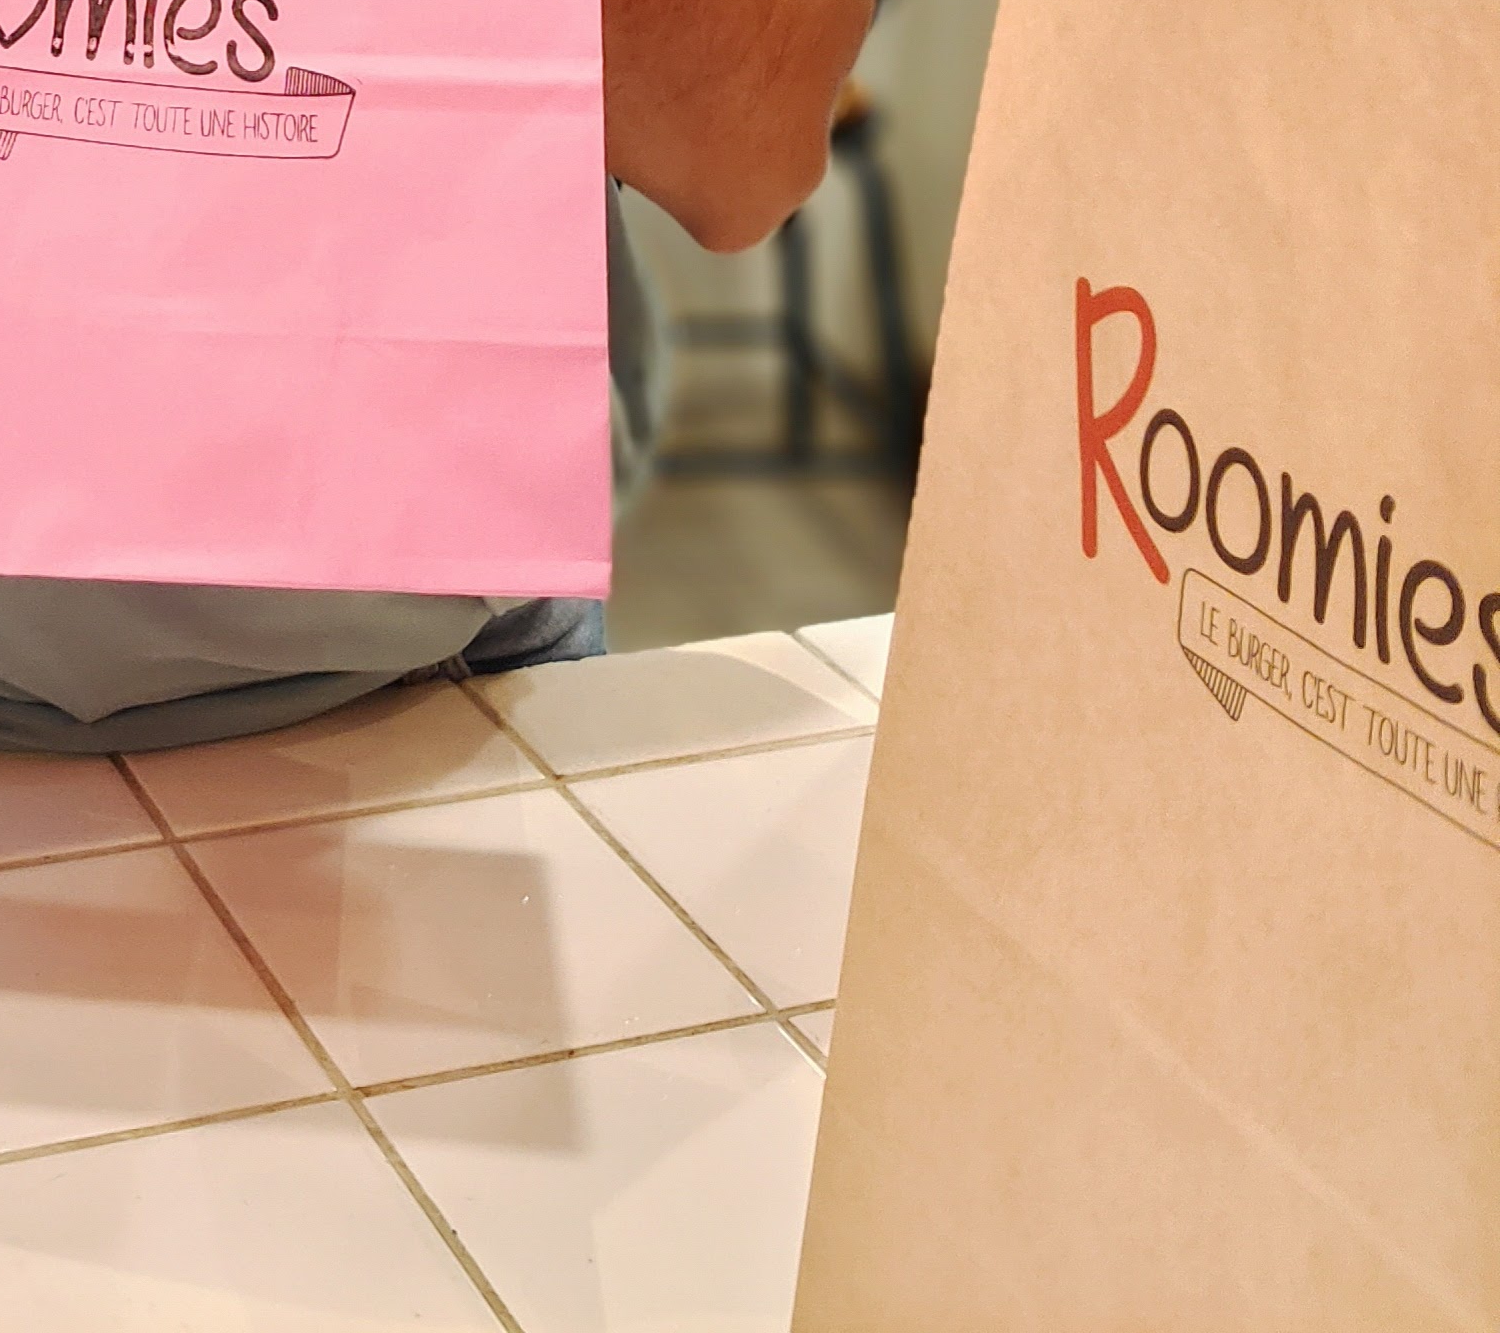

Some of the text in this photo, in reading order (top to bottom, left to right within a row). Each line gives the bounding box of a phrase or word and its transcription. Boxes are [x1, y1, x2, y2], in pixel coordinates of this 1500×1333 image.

[74, 97, 123, 128] C'EST
[131, 103, 192, 135] TOUTE
[200, 109, 236, 138] UNE
[244, 111, 319, 142] HISTOIRE
[1200, 601, 1221, 646] LE
[1302, 670, 1356, 731] C'EST
[1363, 705, 1437, 784] TOUTE
[1445, 750, 1487, 815] UNE
